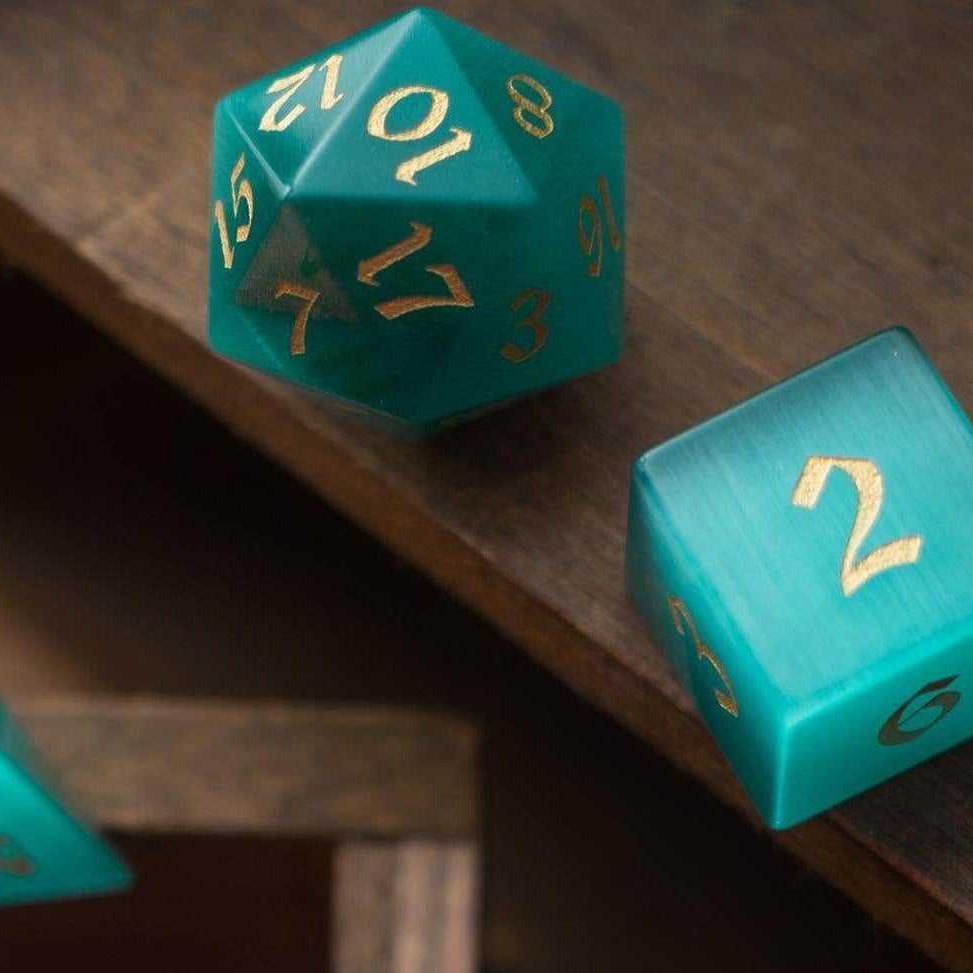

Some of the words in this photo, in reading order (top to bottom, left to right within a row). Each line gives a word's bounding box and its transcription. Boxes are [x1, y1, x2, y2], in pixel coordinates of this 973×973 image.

[258, 53, 345, 131] 12
[367, 84, 472, 186] 10
[506, 73, 554, 139] 8
[214, 153, 255, 269] 15
[357, 220, 475, 320] 17
[275, 280, 320, 355] 7
[502, 287, 550, 363] 3
[791, 455, 923, 597] 2
[667, 594, 738, 718] 3
[878, 674, 961, 746] 6
